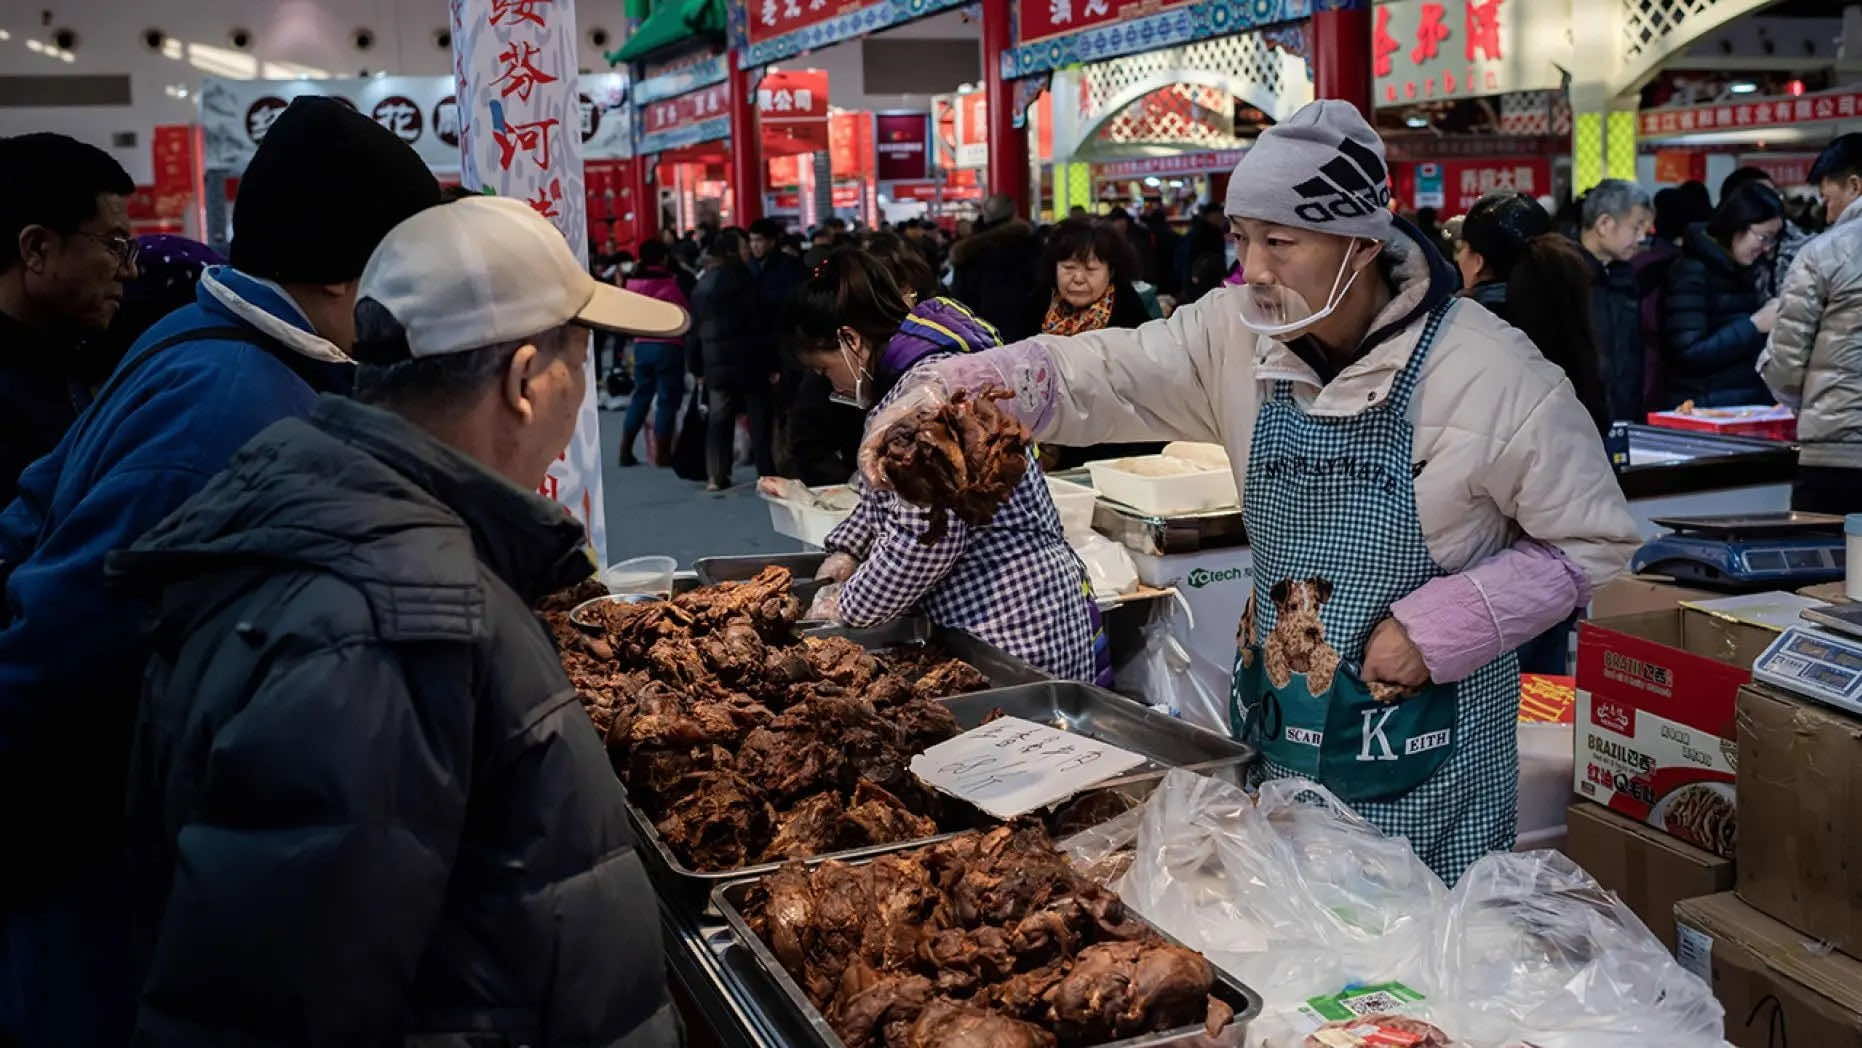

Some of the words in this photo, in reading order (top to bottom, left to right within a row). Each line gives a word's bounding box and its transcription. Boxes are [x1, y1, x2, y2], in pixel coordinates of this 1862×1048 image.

[1287, 729, 1322, 746] SCAR
[1356, 706, 1399, 761] K
[1410, 731, 1447, 752] EITH
[1587, 733, 1627, 763] BRAZIL
